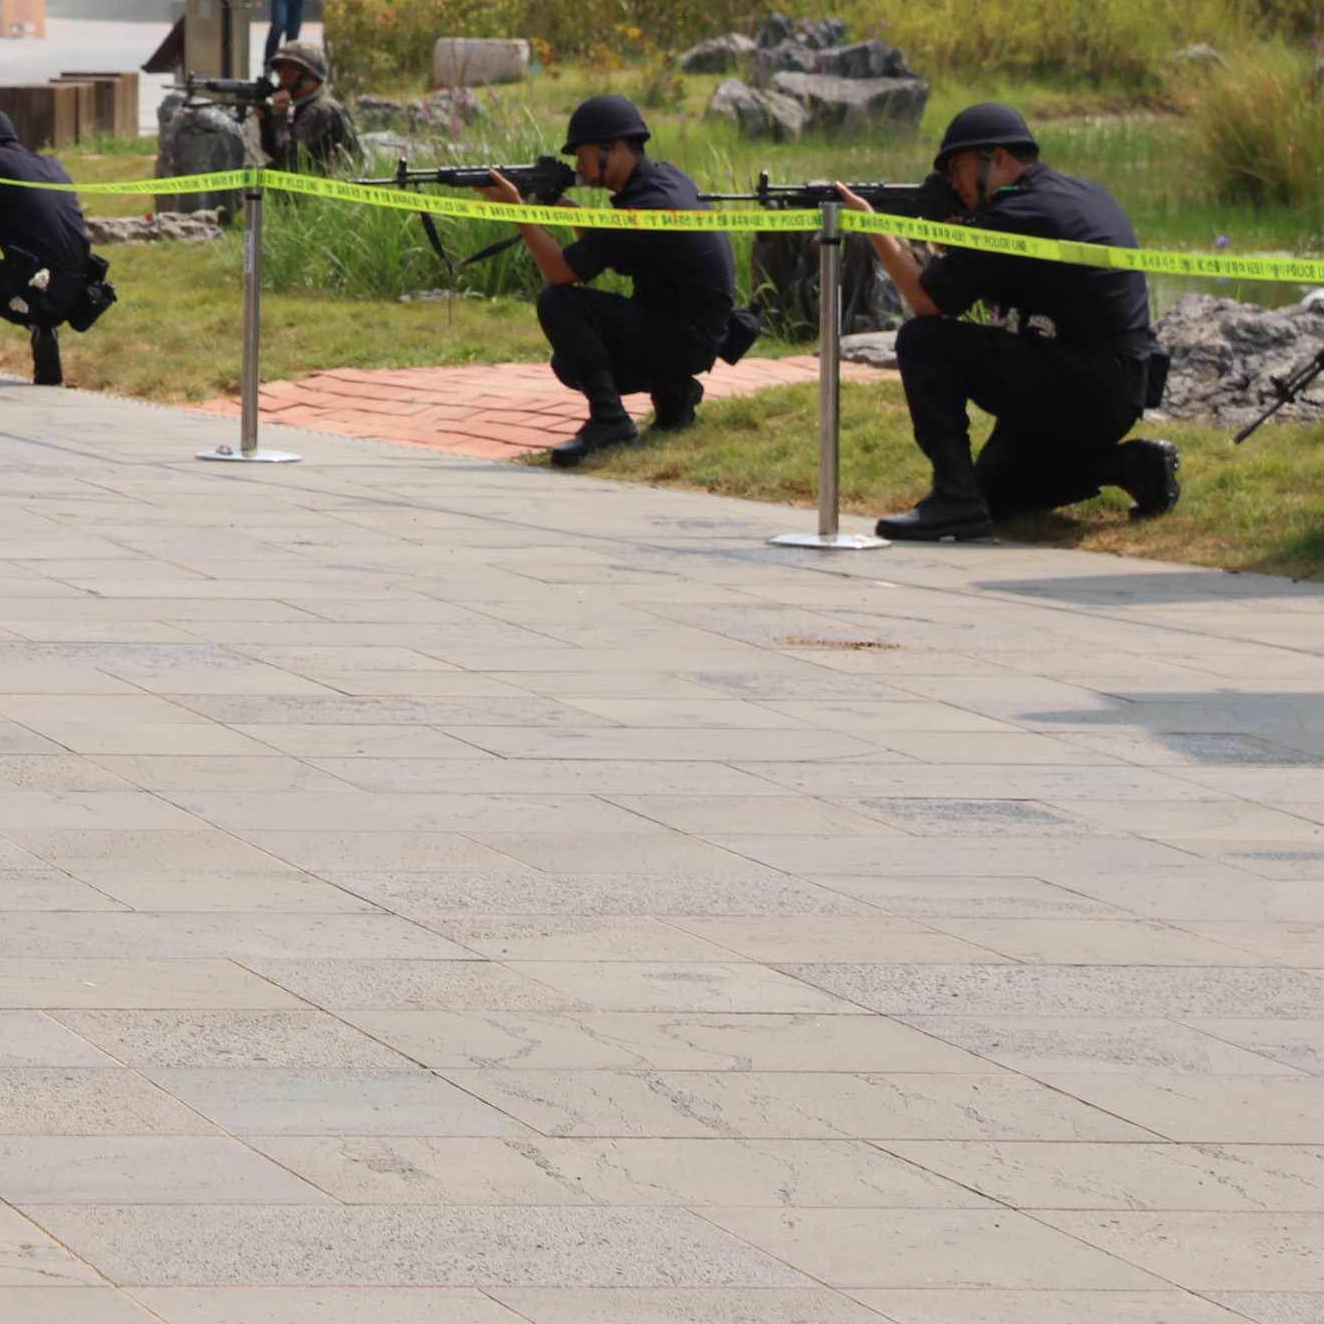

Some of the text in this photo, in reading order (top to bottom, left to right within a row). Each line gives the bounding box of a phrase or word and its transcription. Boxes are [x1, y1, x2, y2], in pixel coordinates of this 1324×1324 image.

[599, 214, 621, 224] POLICE
[781, 214, 822, 225] POLICE LINE
[984, 234, 1027, 251] POLICE LINE
[1286, 263, 1315, 277] POLICE
